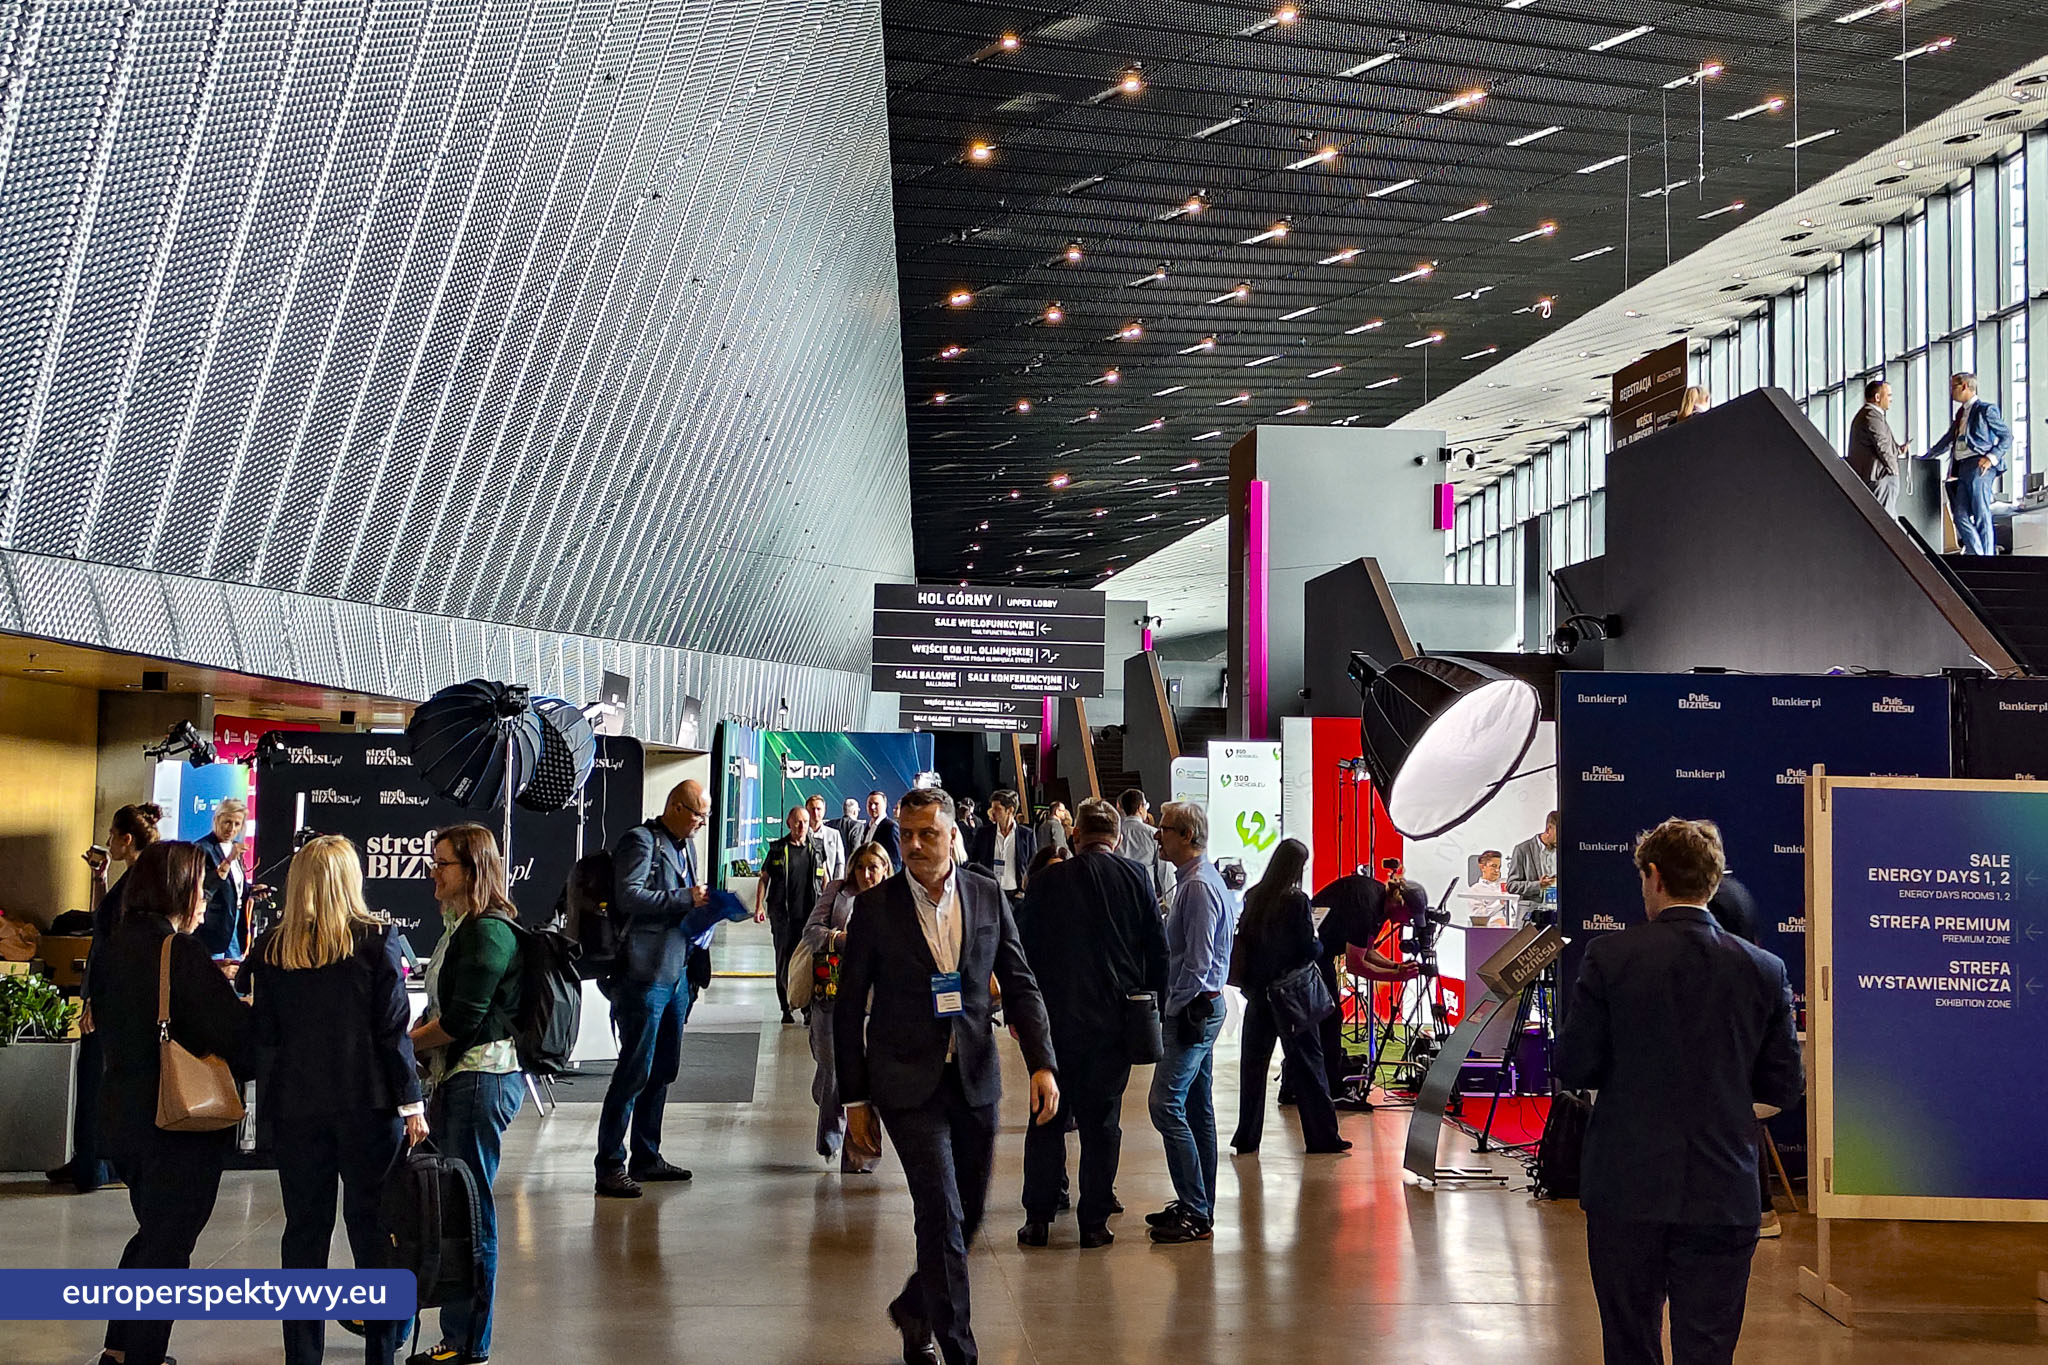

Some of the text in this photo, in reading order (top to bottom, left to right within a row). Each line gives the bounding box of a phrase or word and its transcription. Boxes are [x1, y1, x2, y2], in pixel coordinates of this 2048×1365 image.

[918, 590, 993, 606] HOL GÓRNY
[1006, 599, 1058, 608] UPPER LOBBY
[934, 618, 1035, 631] SALE WIELOFUNKCYJNE
[912, 643, 1034, 657] WEJŚCIE OD UL. OLIMPIJSKIEJ
[896, 670, 957, 681] SALE BALOWE
[967, 672, 1063, 685] SALE KONFERENCYJNE
[1688, 693, 1710, 702] Puls
[1882, 696, 1903, 706] Puls
[1678, 699, 1721, 710] Biznesu
[1872, 702, 1915, 713] Biznesu
[366, 747, 396, 757] strefa
[805, 763, 835, 780] rp.pl
[1592, 766, 1613, 775] Puls
[1786, 768, 1807, 777] Puls
[1582, 771, 1625, 782] Biznesu
[1776, 774, 1806, 785] Bizne
[311, 788, 337, 797] strefa
[380, 789, 405, 798] strefa
[366, 830, 437, 855] stref
[1773, 844, 1805, 854] Banki
[1969, 854, 2011, 868] SALE
[1868, 868, 2011, 887] ENERGY DAYS 1, 2
[1899, 889, 2011, 901] ENERGY DAYS ROOMS 1, 2
[1593, 914, 1614, 924] Puls
[1869, 914, 2011, 932] STREFA PREMIUM
[1582, 920, 1626, 931] Biznesu
[1777, 922, 1806, 933] Bizn
[1942, 934, 2011, 945] PREMIUM ZONE
[1517, 944, 1541, 966] Puls
[1512, 941, 1557, 983] Biznesu
[1949, 960, 2011, 976] STREFA
[1858, 975, 2011, 993] WYSTAWIENNICZA
[1935, 998, 2012, 1009] EXHIBITION ZONE
